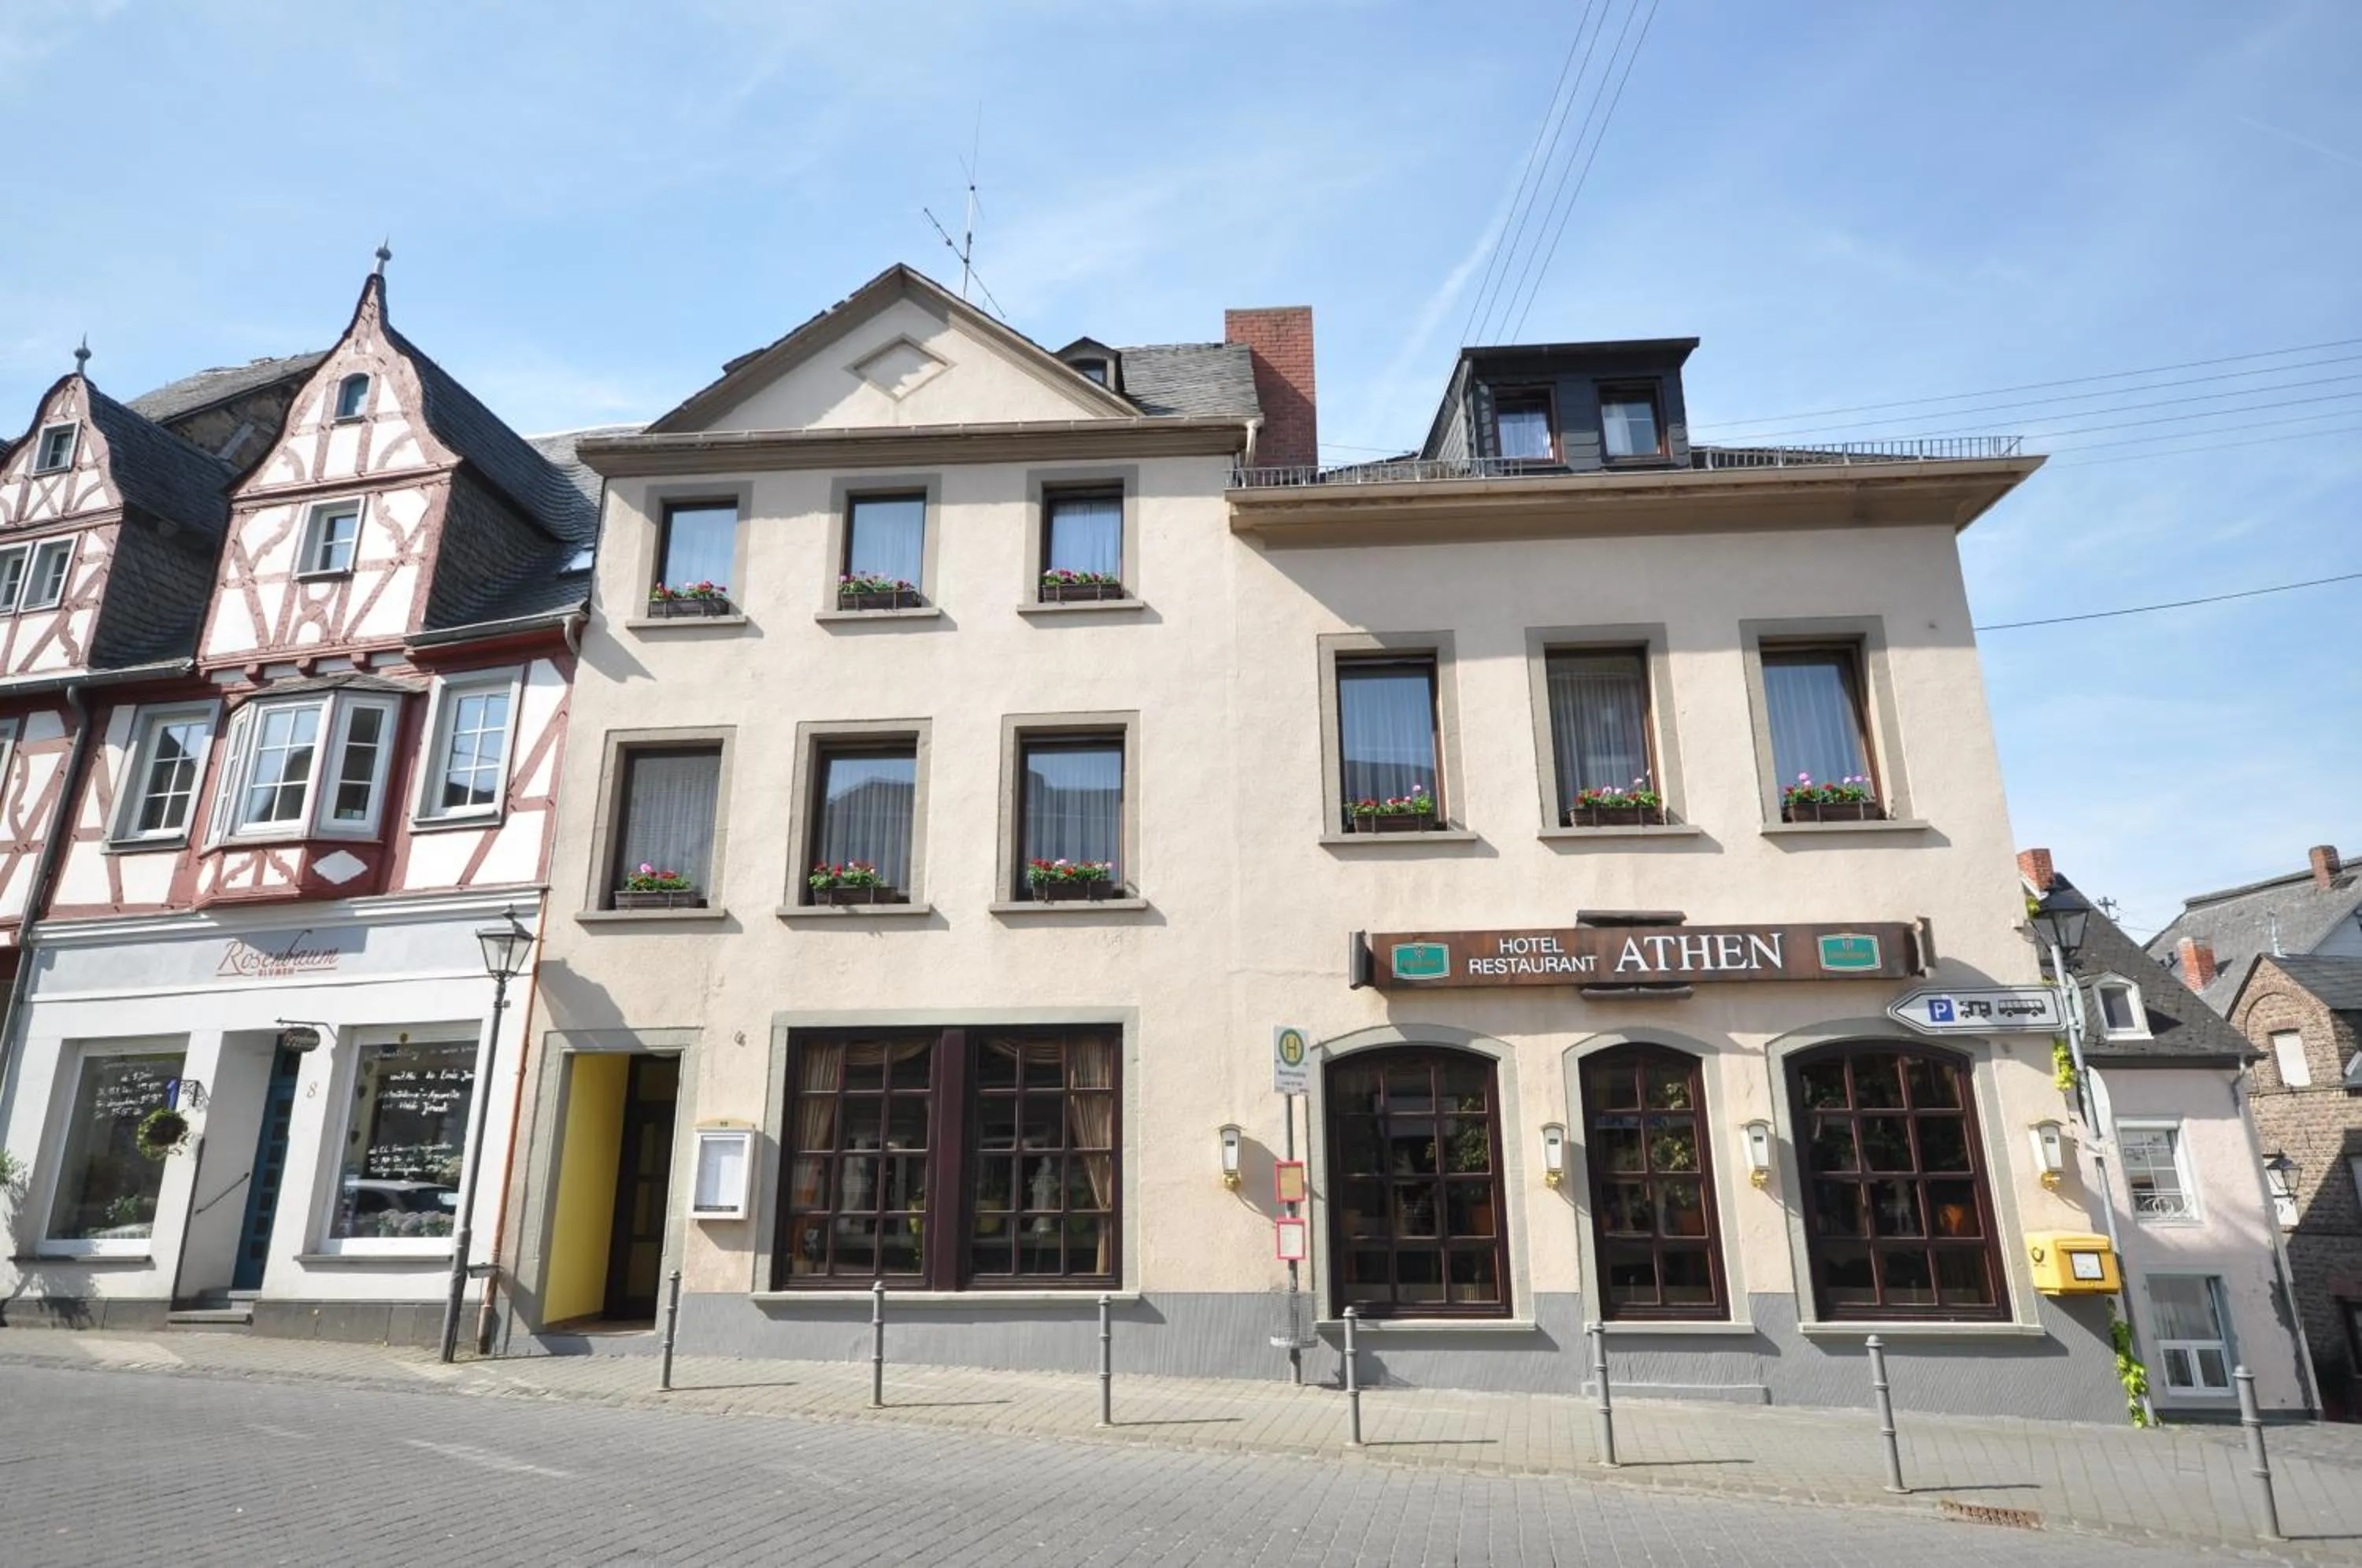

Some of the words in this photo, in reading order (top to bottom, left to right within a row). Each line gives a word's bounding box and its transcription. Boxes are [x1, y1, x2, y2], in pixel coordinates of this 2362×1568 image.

[217, 929, 339, 976] Rosenbaum
[1499, 937, 1564, 955] HOTEL
[1615, 933, 1783, 974] ATHEN
[1468, 955, 1598, 975] RESTAURANT
[1934, 1001, 1948, 1019] P
[1285, 1037, 1298, 1059] H
